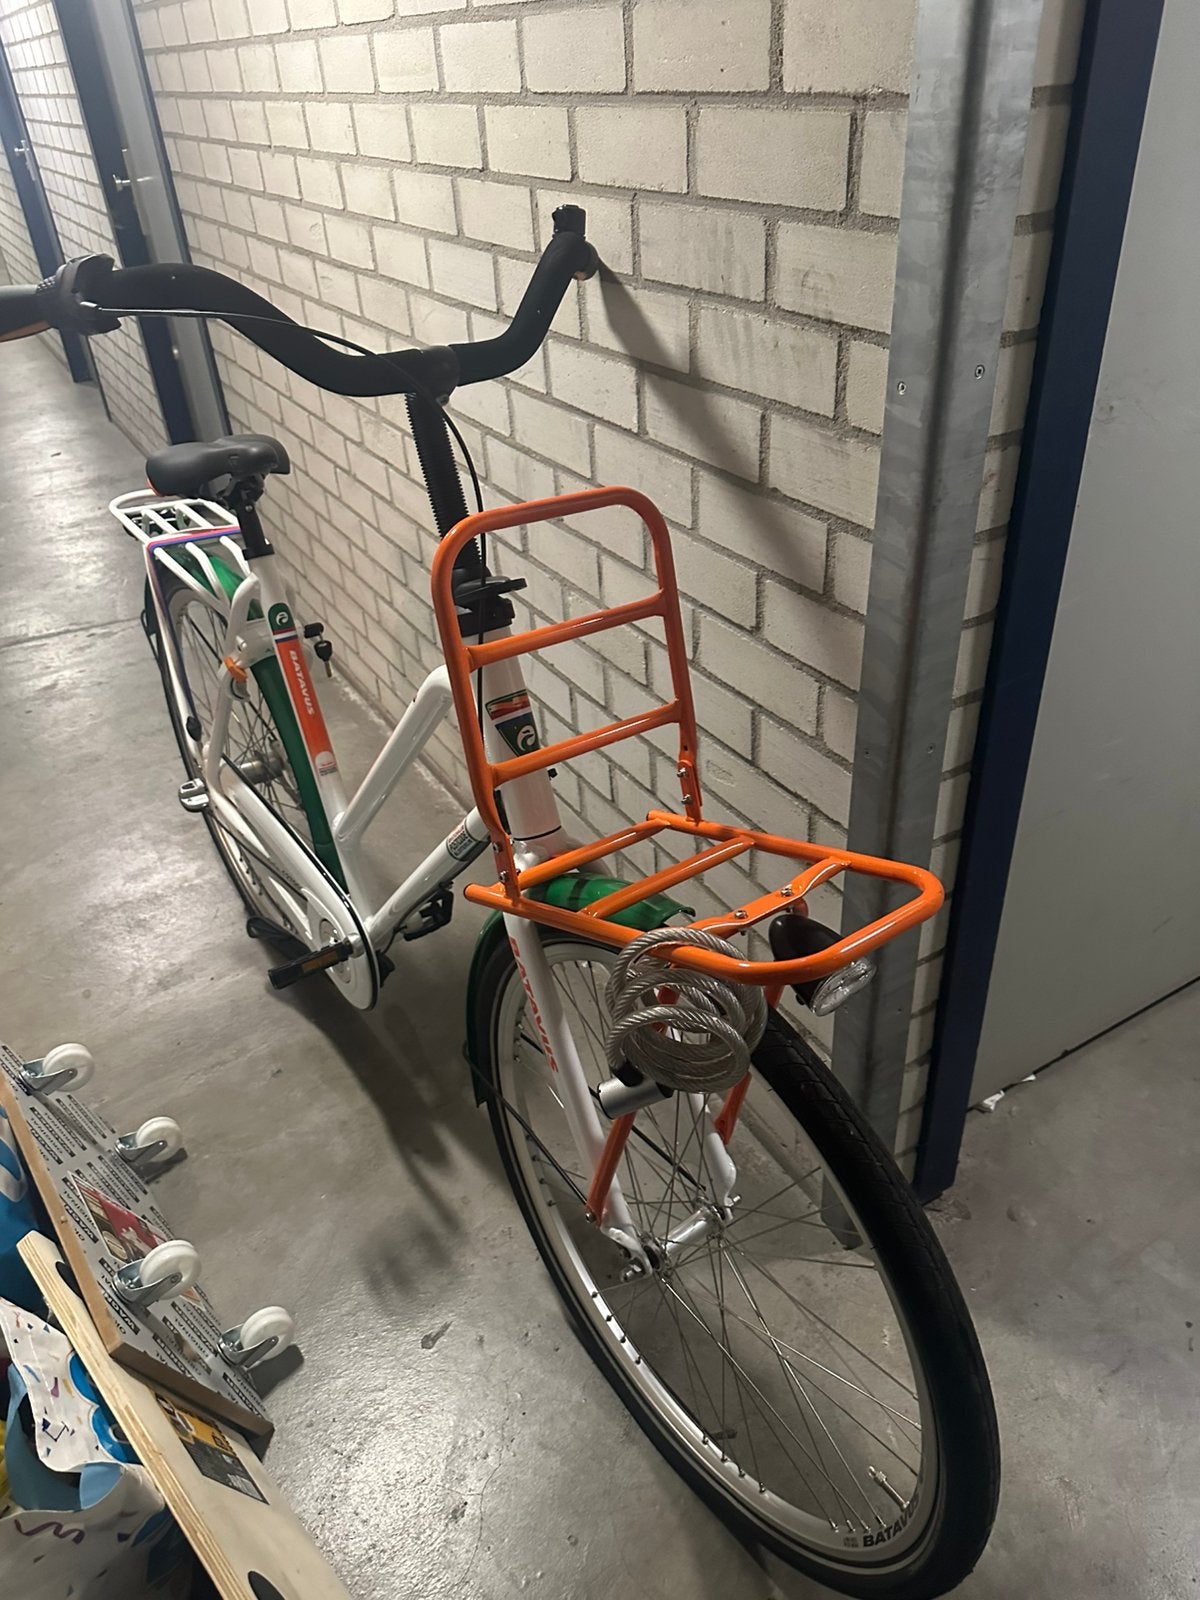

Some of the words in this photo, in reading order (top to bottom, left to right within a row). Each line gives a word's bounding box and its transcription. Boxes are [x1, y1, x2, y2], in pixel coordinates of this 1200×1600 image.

[288, 649, 316, 717] BATAVUS
[63, 1203, 95, 1239] WAGN
[101, 1290, 136, 1330] WAGN
